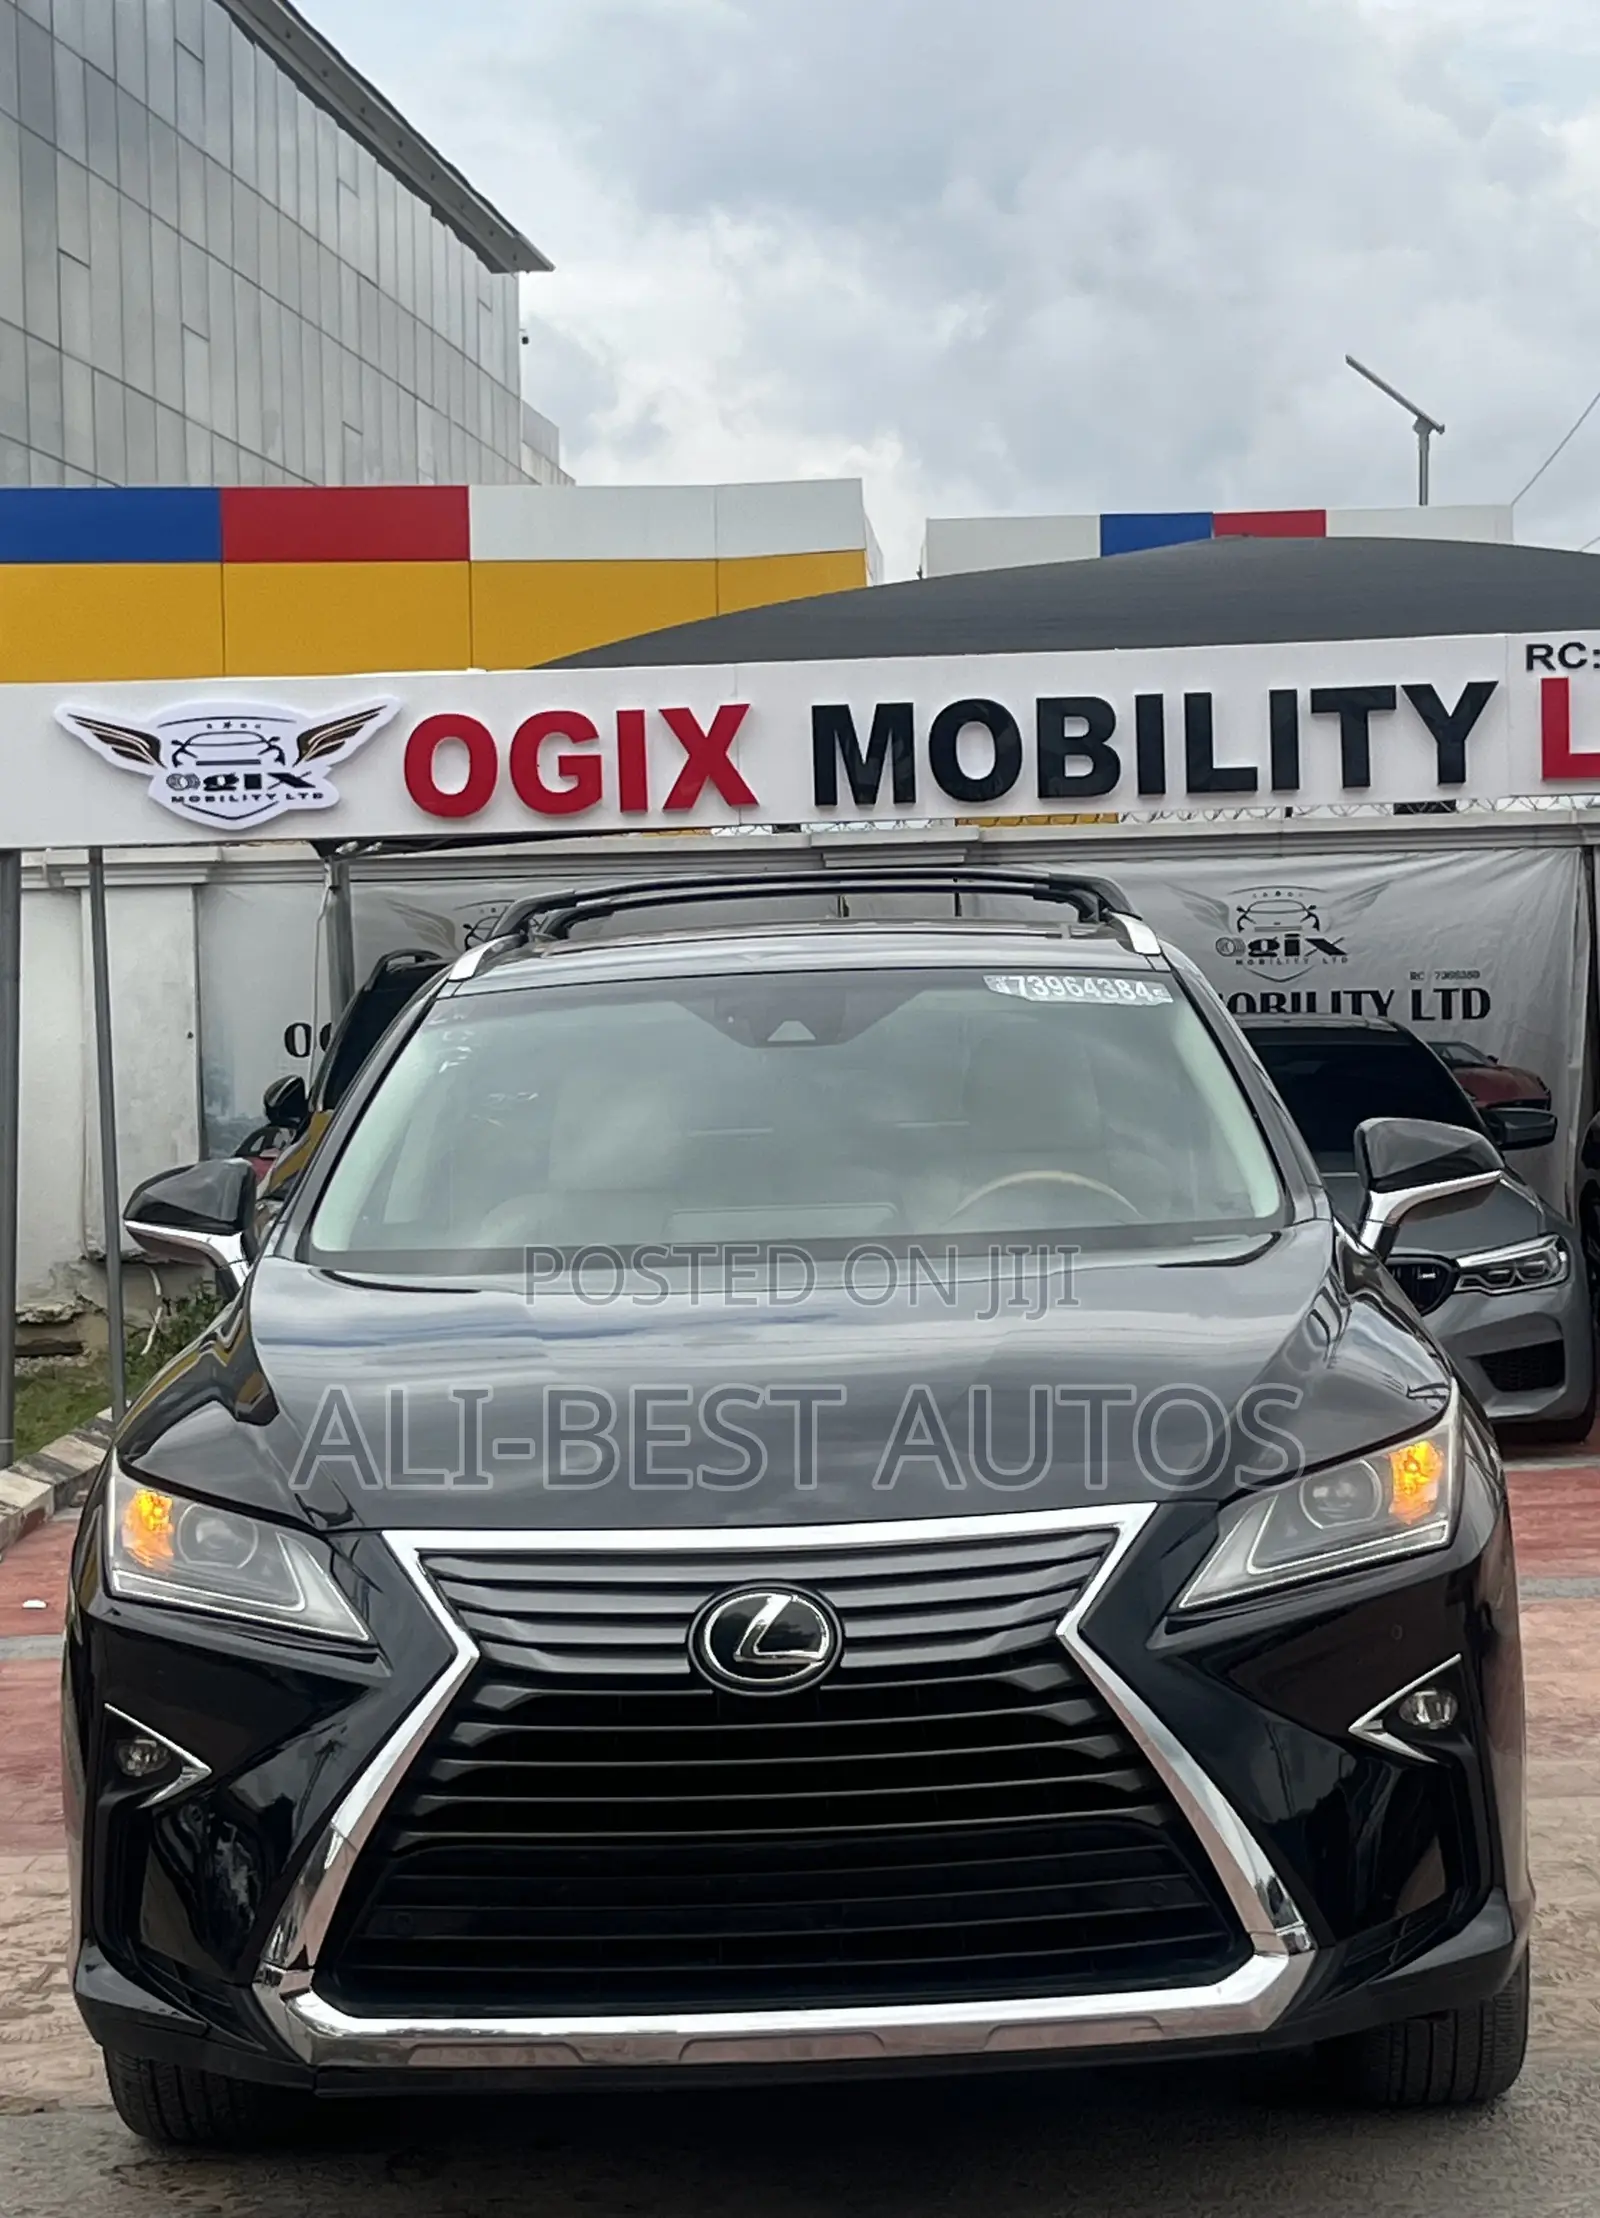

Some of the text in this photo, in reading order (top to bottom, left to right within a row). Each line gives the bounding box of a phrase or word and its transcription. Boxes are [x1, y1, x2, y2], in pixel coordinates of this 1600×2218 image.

[404, 703, 760, 819] OGIX
[812, 680, 1499, 807] MOBILITY
[171, 792, 324, 803] MOBILITY LTD
[1218, 987, 1491, 1020] OBILITY LTD
